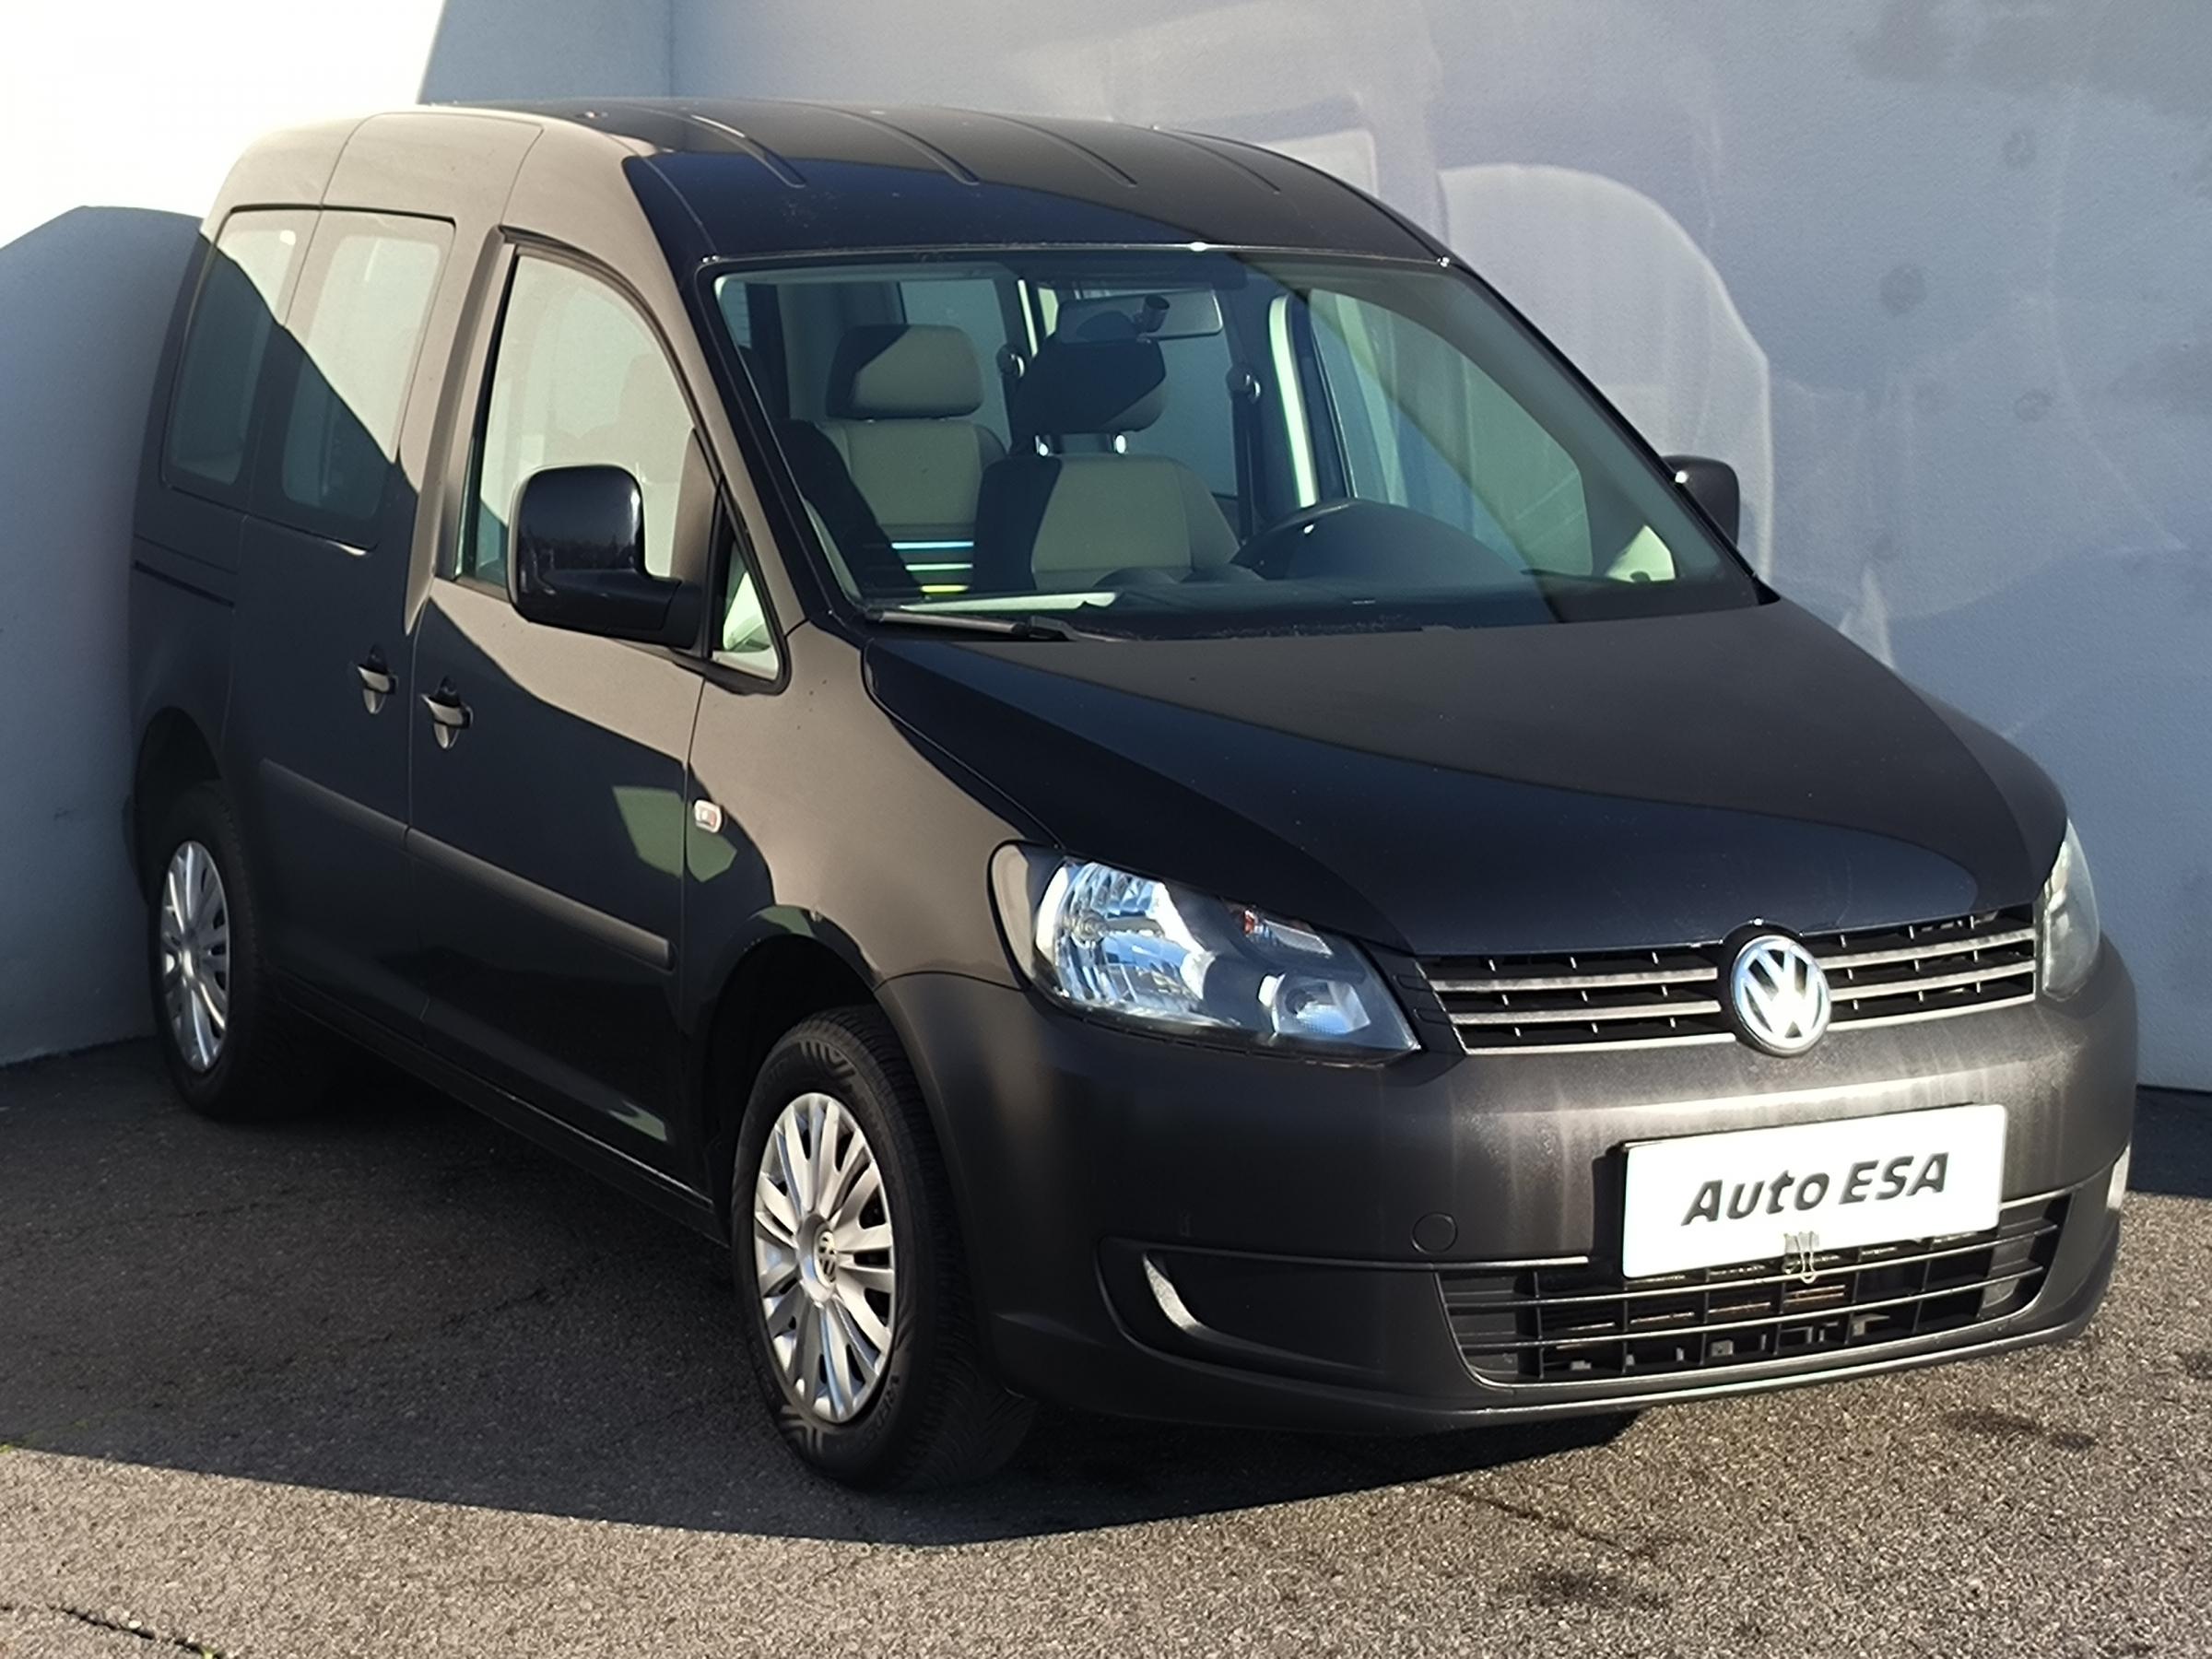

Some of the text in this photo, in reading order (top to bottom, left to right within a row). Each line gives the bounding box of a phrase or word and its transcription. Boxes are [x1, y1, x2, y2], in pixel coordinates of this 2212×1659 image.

[1734, 937, 1829, 1051] VW
[1680, 1151, 1949, 1227] Auto ESA
